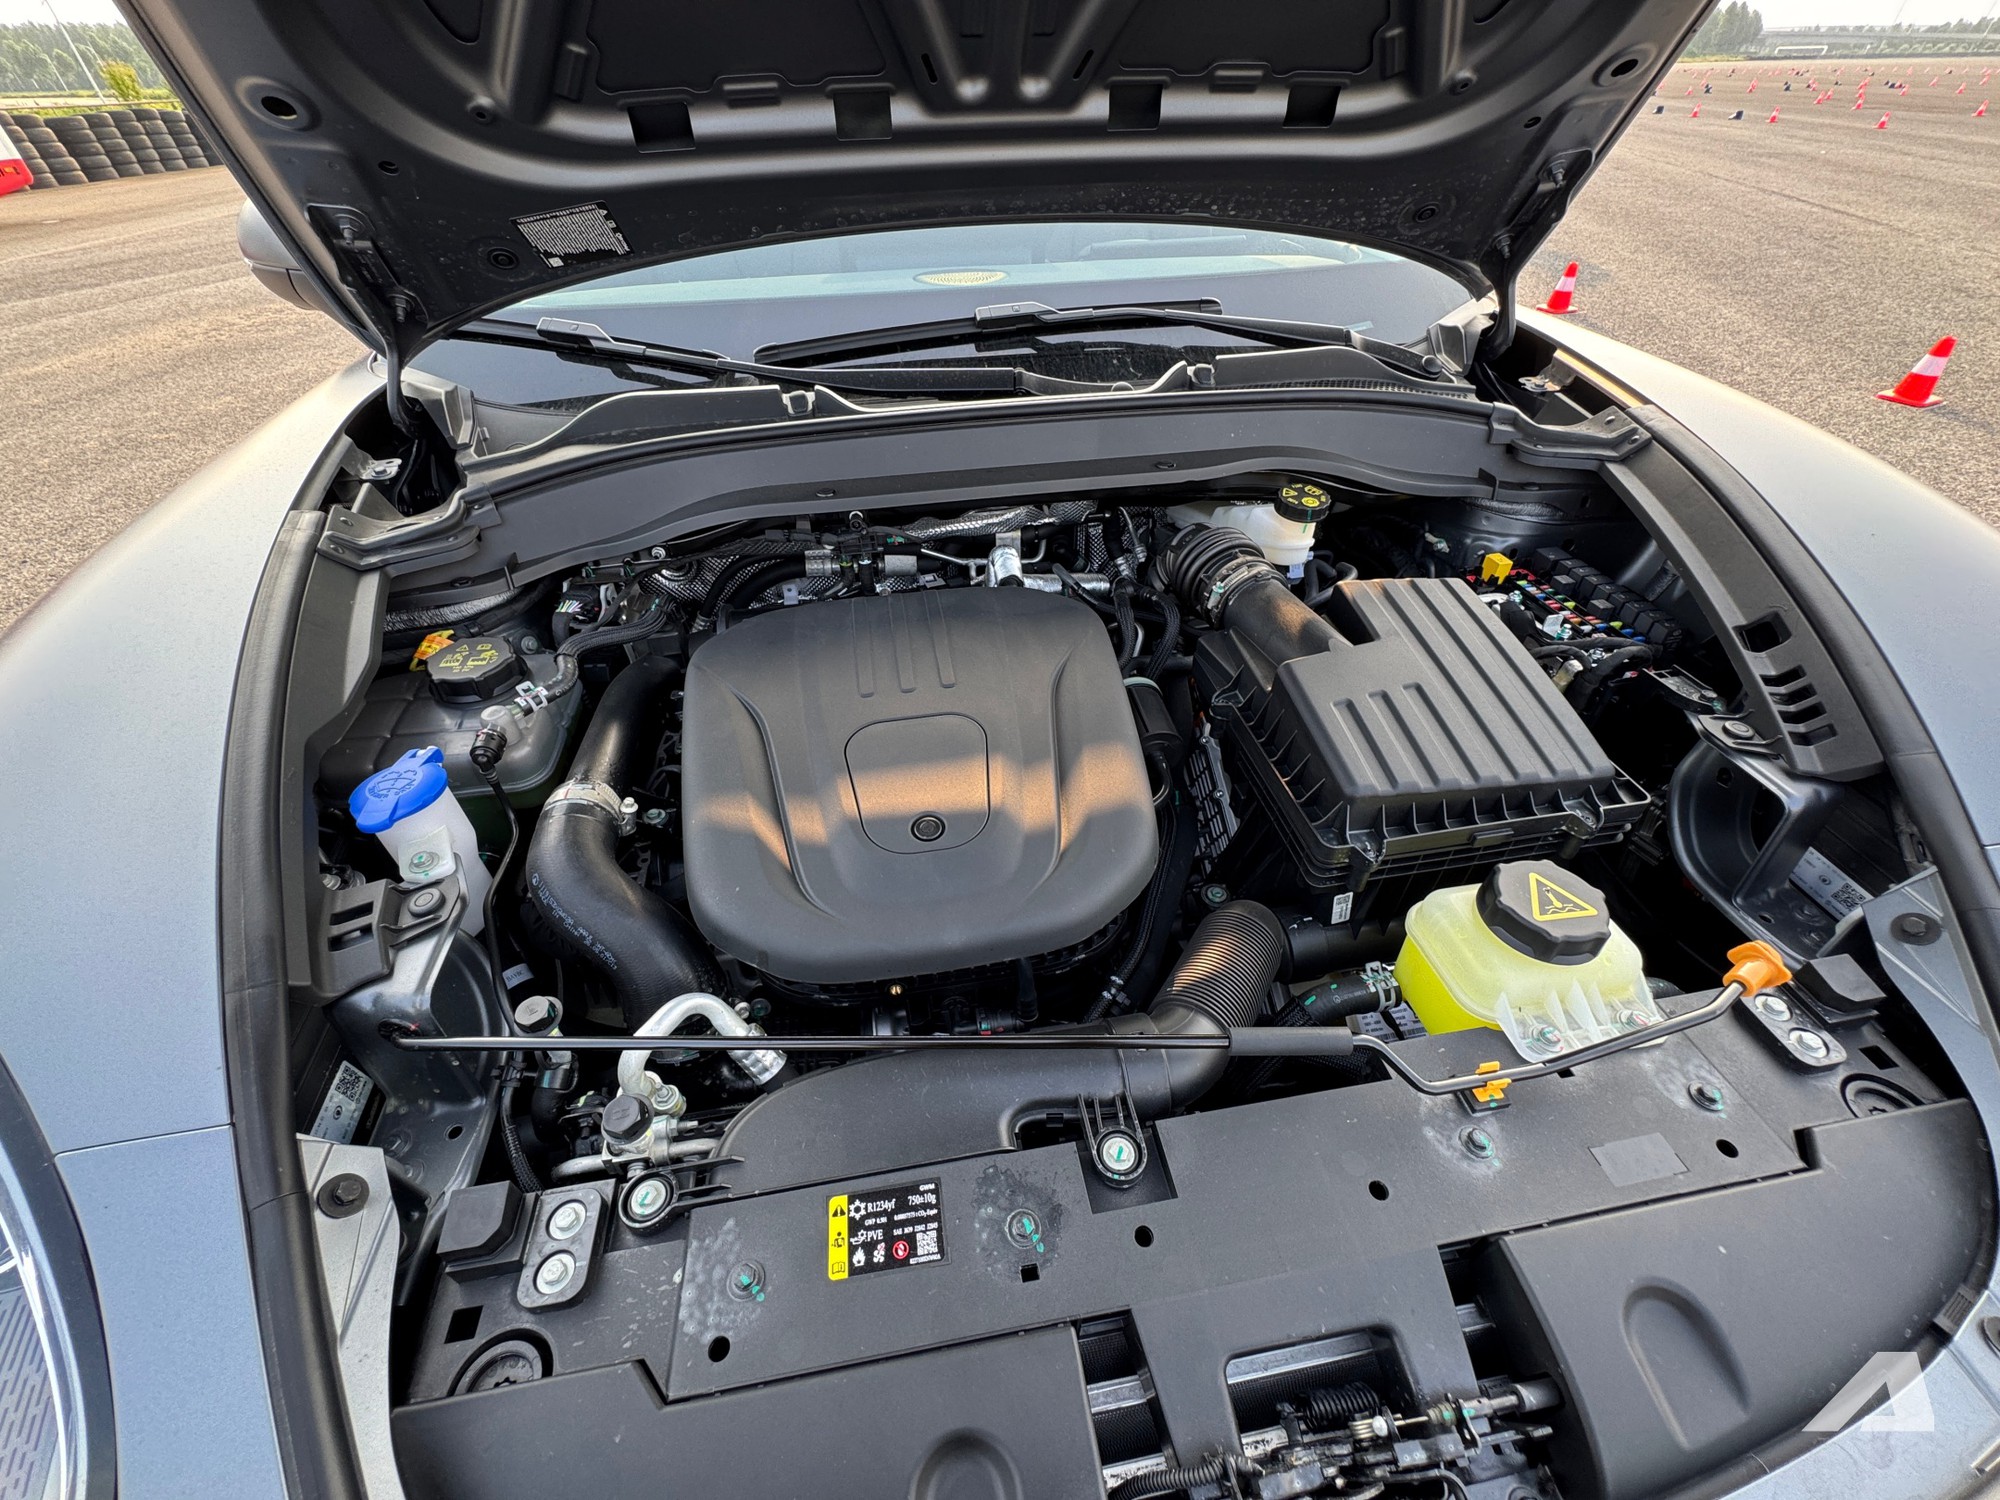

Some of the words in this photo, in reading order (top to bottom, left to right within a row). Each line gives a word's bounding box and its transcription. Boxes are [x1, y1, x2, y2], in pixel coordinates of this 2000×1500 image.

[867, 1198, 896, 1212] R1234yf
[908, 1193, 936, 1206] 750±10g
[867, 1229, 883, 1242] PVE
